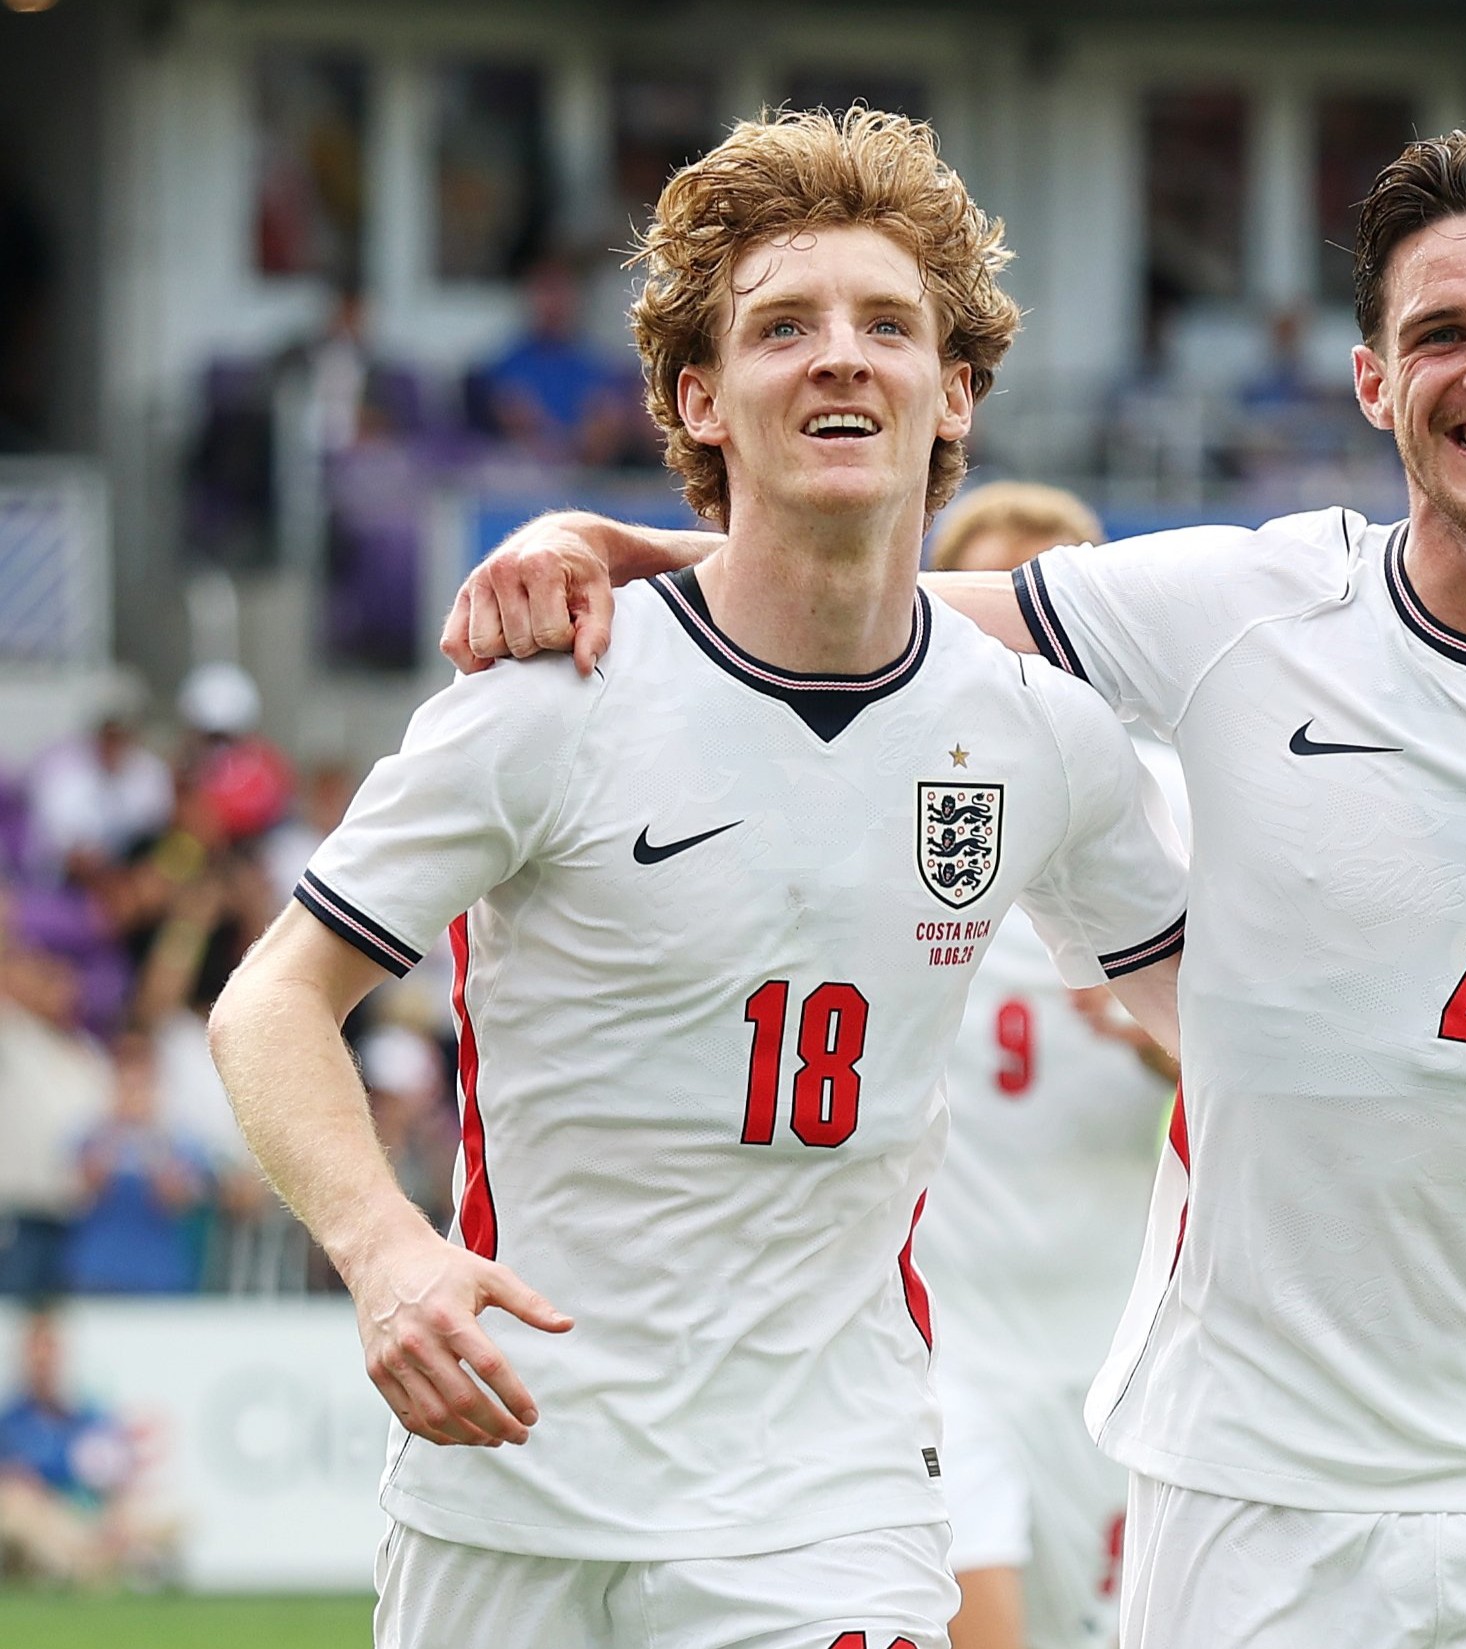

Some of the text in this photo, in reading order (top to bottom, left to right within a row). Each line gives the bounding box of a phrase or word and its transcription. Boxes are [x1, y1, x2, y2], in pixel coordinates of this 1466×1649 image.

[916, 919, 991, 941] COSTA RICA
[929, 945, 975, 966] 10.06.26
[740, 979, 870, 1149] 18
[995, 1000, 1032, 1095] 9
